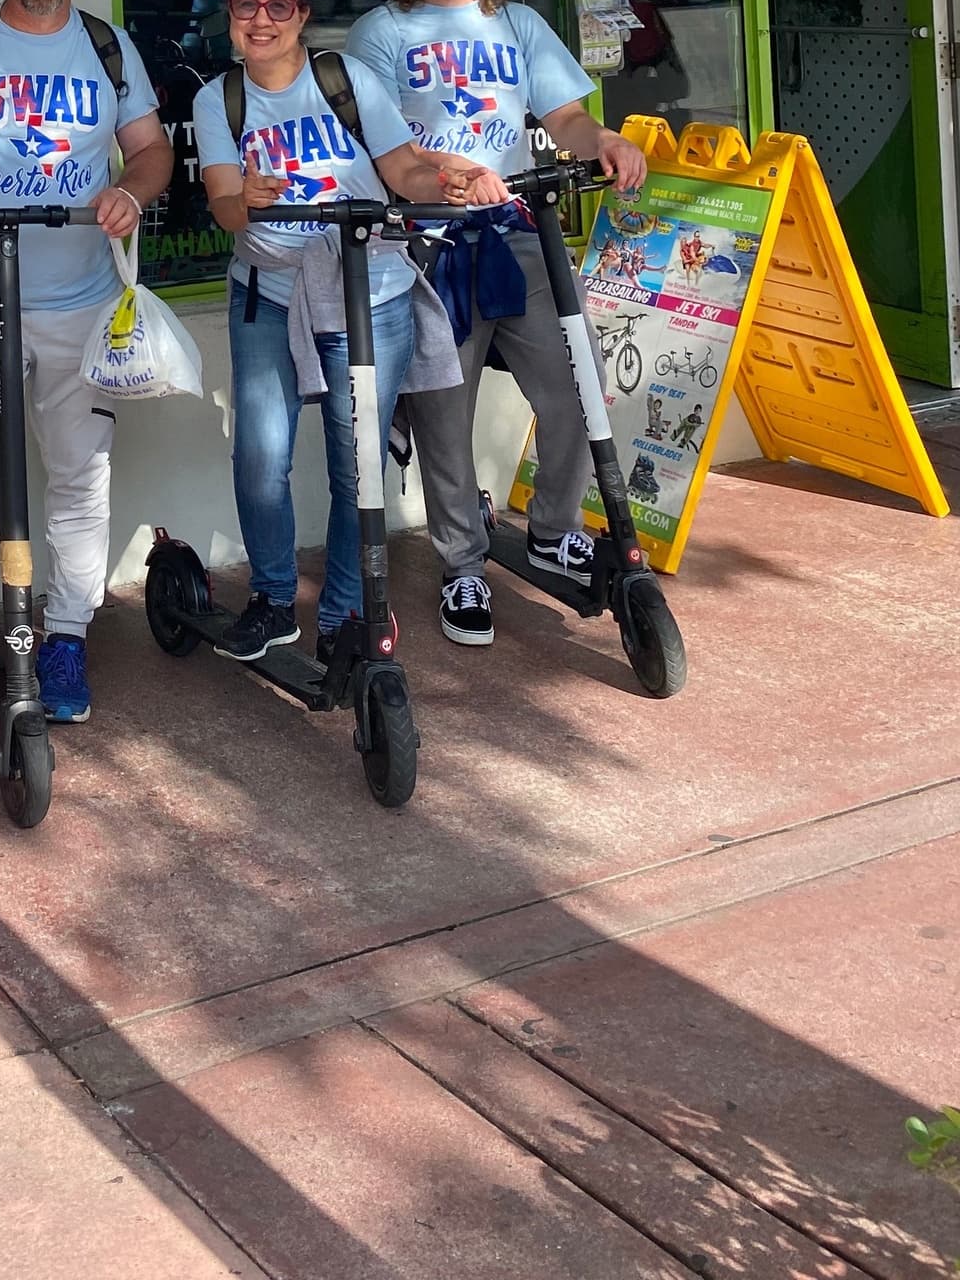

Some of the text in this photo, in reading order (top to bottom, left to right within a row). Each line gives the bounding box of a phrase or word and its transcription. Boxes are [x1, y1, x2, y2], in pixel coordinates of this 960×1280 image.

[406, 40, 520, 89] SWAU
[241, 114, 355, 176] SWAU
[408, 118, 518, 153] Puerto Rico
[56, 159, 92, 197] Rico
[695, 195, 744, 211] 786.622.1305
[142, 228, 234, 262] BAHAM
[584, 277, 652, 304] PARASAILING
[669, 316, 698, 330] TANDEM
[675, 301, 721, 321] JET SKI
[90, 366, 155, 388] Thank You!
[648, 383, 687, 400] BABY SEAT
[631, 438, 684, 462] ROLLERBLADES
